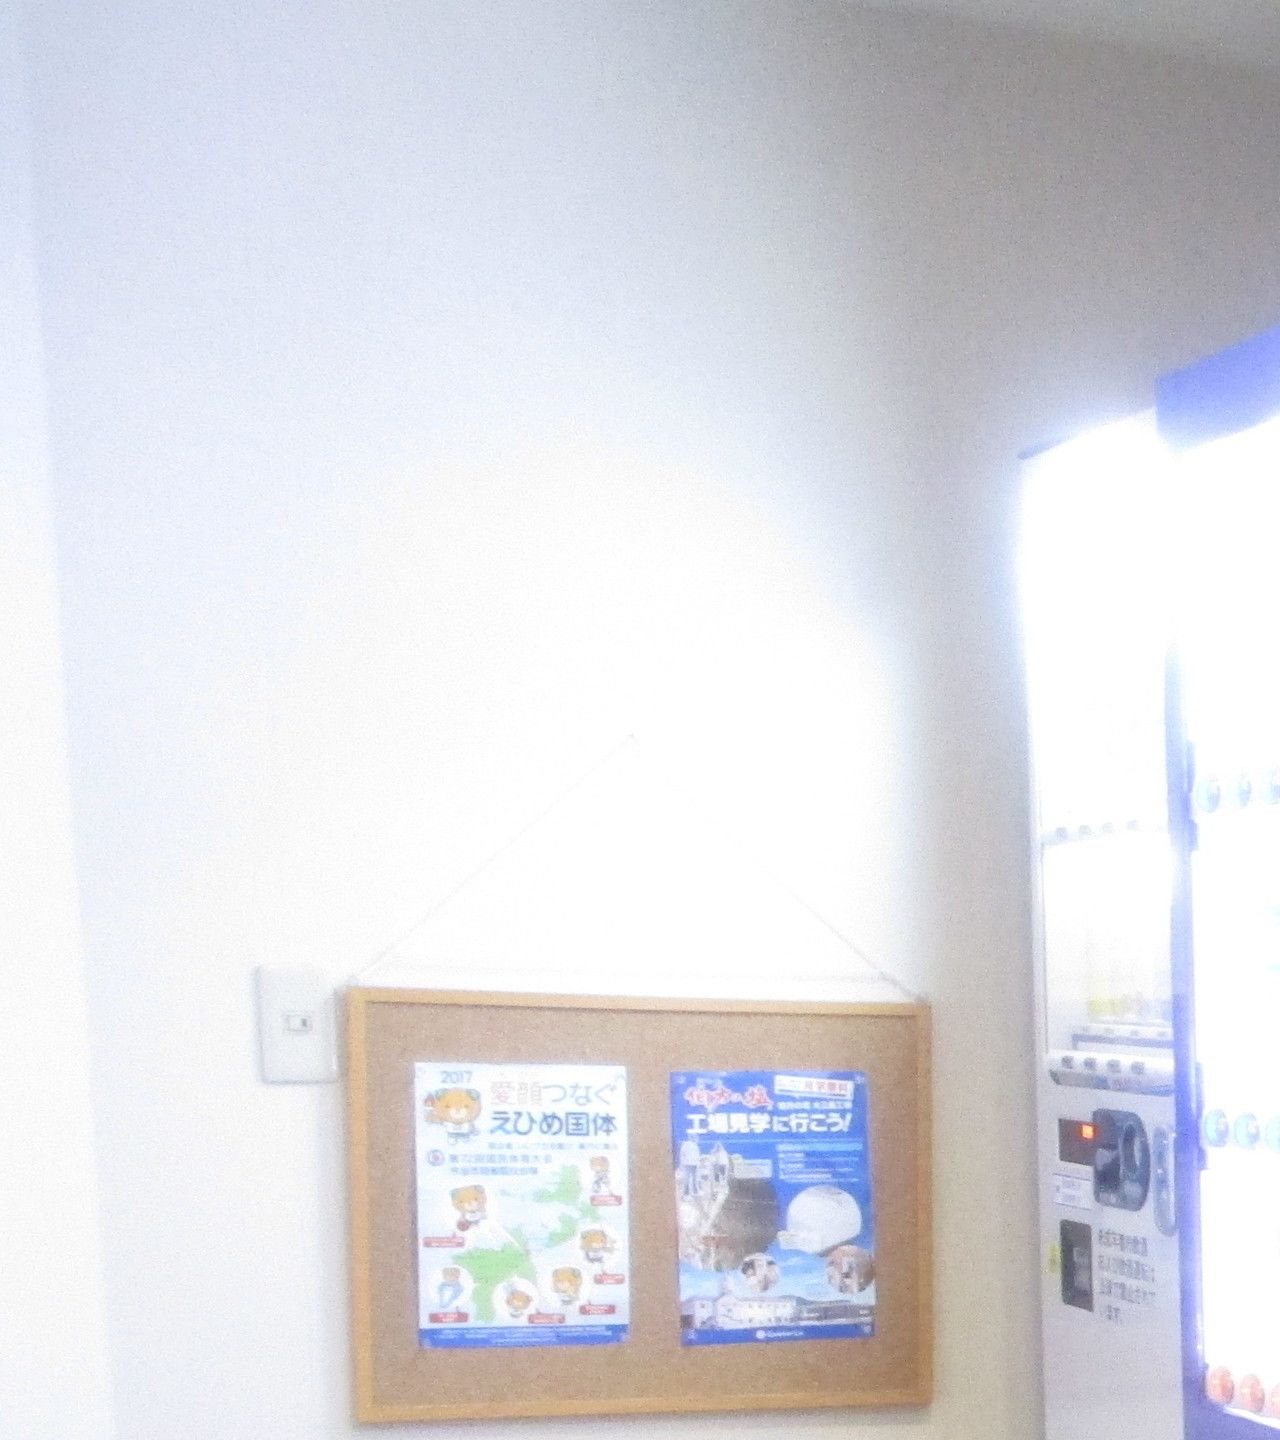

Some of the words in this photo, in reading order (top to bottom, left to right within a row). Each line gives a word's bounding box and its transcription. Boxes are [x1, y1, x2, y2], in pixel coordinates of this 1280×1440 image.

[440, 1070, 473, 1084] 2017
[489, 1110, 618, 1137] えひめ国体
